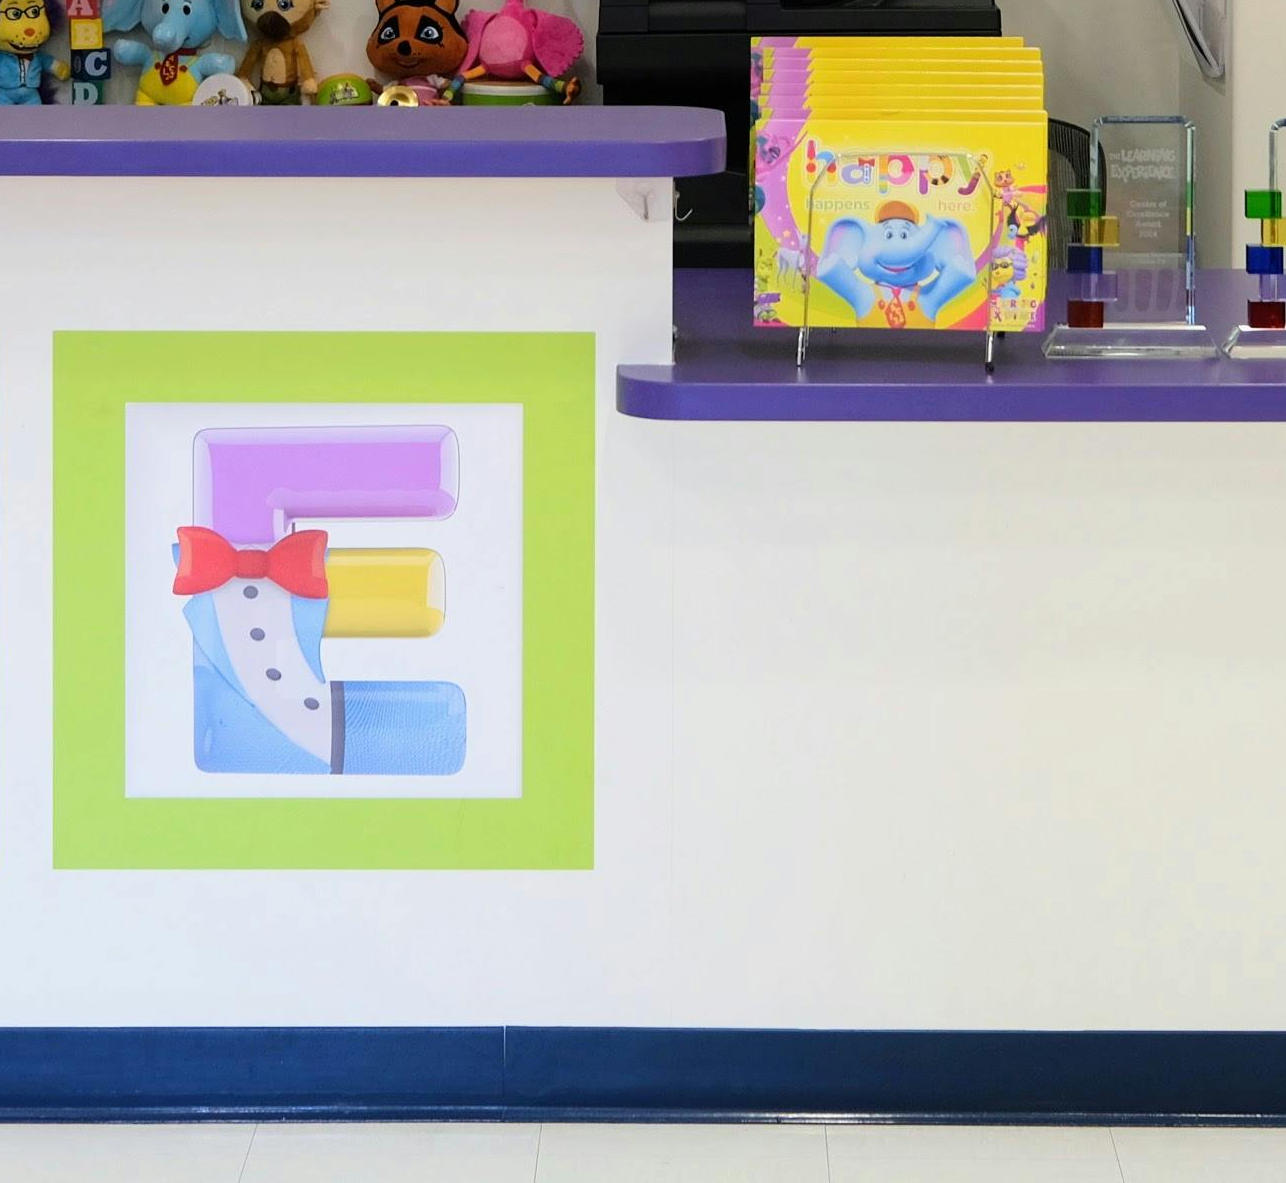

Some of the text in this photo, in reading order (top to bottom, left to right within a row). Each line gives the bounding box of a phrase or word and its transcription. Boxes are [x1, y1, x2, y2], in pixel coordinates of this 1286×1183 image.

[75, 25, 99, 45] B
[84, 51, 108, 77] C
[73, 82, 99, 106] D
[805, 139, 983, 196] happy
[805, 198, 870, 211] happens
